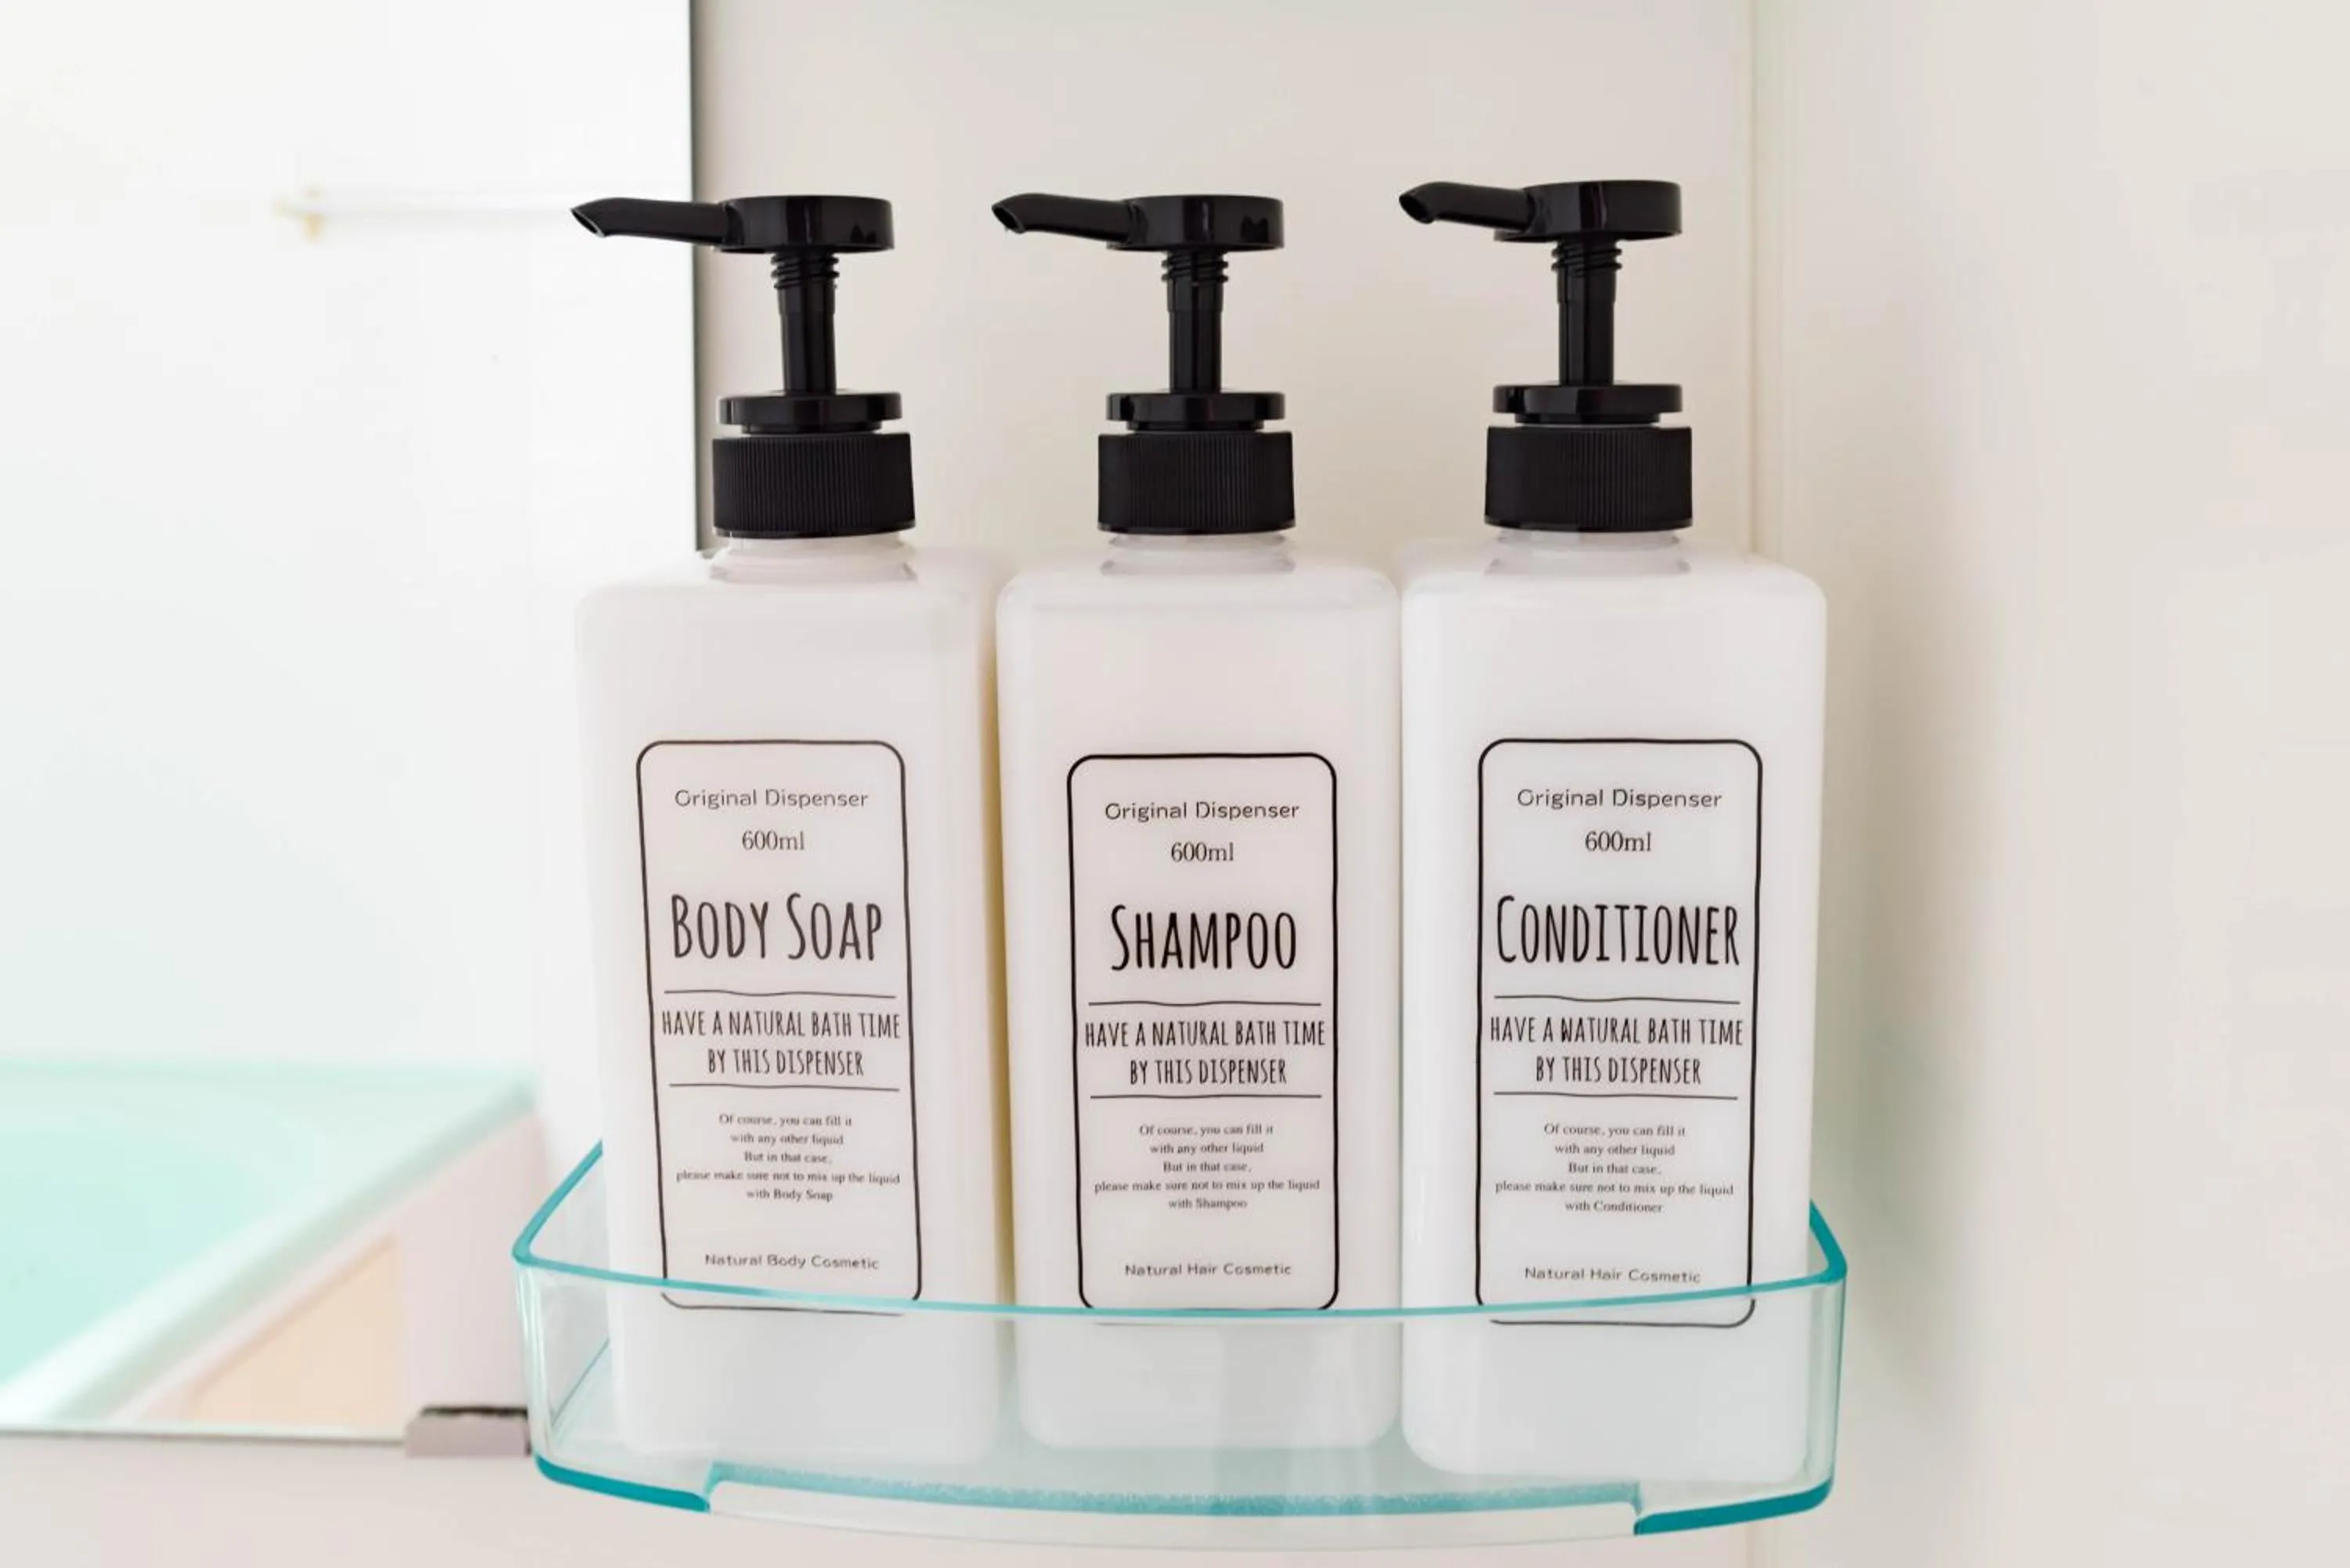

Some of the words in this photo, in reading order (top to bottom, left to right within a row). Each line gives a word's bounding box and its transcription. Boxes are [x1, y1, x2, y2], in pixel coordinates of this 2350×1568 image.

[674, 789, 757, 810] Original
[765, 789, 869, 810] Dispenser
[1517, 789, 1603, 810] Original
[1613, 789, 1722, 810] Dispenser
[1105, 802, 1187, 822] Original
[1196, 801, 1300, 821] Dispenser
[742, 830, 804, 851] 600ml
[1585, 830, 1651, 851] 600ml
[1171, 842, 1233, 862] 600ml
[671, 894, 768, 959] BODY
[786, 892, 882, 961] SOAP
[1497, 895, 1739, 965] CONDITIONER
[1111, 904, 1296, 971] SHAMPOO
[662, 1010, 706, 1036] HAVE
[712, 1010, 723, 1035] A
[729, 1010, 805, 1037] NATURAL
[812, 1011, 851, 1037] BATH
[858, 1013, 900, 1039] TIME
[1086, 1022, 1128, 1047] HAVE
[1135, 1021, 1146, 1046] A
[1152, 1021, 1228, 1046] NATURAL
[1235, 1020, 1275, 1046] BATH
[1283, 1021, 1325, 1046] TIME
[1491, 1017, 1535, 1042] HAVE
[1542, 1017, 1553, 1042] A
[1560, 1017, 1640, 1044] NATURAL
[1648, 1017, 1690, 1044] BATH
[1698, 1019, 1742, 1046] TIME
[708, 1049, 725, 1074] BY
[733, 1049, 770, 1075] THIS
[776, 1050, 863, 1076] DISPENSER
[1130, 1060, 1148, 1085] BY
[1155, 1059, 1192, 1085] THIS
[1198, 1058, 1286, 1084] DISPENSER
[1536, 1056, 1555, 1082] BY
[1562, 1056, 1601, 1082] THIS
[1608, 1057, 1701, 1084] DISPENSER
[719, 1114, 733, 1124] Of
[779, 1117, 800, 1128] you
[826, 1115, 841, 1127] fill
[845, 1118, 851, 1126] it
[1139, 1125, 1155, 1136] Of
[1200, 1126, 1220, 1137] you
[1224, 1125, 1243, 1135] can
[1246, 1123, 1262, 1135] fill
[1266, 1125, 1273, 1134] it
[1544, 1123, 1560, 1134] Of
[1608, 1128, 1629, 1138] you
[1657, 1125, 1674, 1136] fill
[1678, 1128, 1685, 1136] it
[730, 1133, 754, 1143] with
[757, 1135, 776, 1147] any
[779, 1133, 809, 1144] other
[811, 1133, 844, 1147] liquid
[1150, 1143, 1174, 1154] with
[1177, 1145, 1197, 1155] any
[1200, 1142, 1227, 1153] other
[1232, 1141, 1264, 1155] liquid
[744, 1151, 764, 1162] But
[767, 1151, 778, 1162] in
[780, 1151, 801, 1162] that
[1555, 1143, 1580, 1154] with
[1583, 1146, 1604, 1157] any
[1607, 1143, 1637, 1154] other
[1640, 1144, 1675, 1158] liquid
[1163, 1161, 1182, 1172] But
[1187, 1162, 1197, 1172] in
[1199, 1162, 1220, 1172] that
[1568, 1162, 1588, 1173] But
[1593, 1162, 1603, 1173] in
[1607, 1162, 1629, 1174] that
[676, 1169, 710, 1183] please
[714, 1170, 743, 1180] make
[747, 1172, 769, 1181] sure
[772, 1172, 790, 1181] not
[793, 1172, 804, 1181] to
[807, 1172, 827, 1182] mix
[831, 1174, 845, 1185] up
[848, 1172, 865, 1183] the
[869, 1172, 900, 1187] liquid
[1094, 1181, 1129, 1195] please
[1132, 1180, 1162, 1190] make
[1166, 1182, 1188, 1191] sure
[1191, 1181, 1209, 1190] not
[1212, 1180, 1223, 1190] to
[1226, 1180, 1247, 1190] mix
[1250, 1182, 1265, 1193] up
[1267, 1180, 1284, 1190] the
[1288, 1179, 1320, 1192] liquid
[747, 1188, 770, 1199] with
[773, 1188, 802, 1202] Body
[806, 1189, 833, 1203] Soap
[1495, 1180, 1531, 1194] please
[1535, 1181, 1566, 1191] make
[1570, 1183, 1593, 1193] sure
[1597, 1184, 1615, 1193] not
[1619, 1183, 1630, 1193] to
[1634, 1184, 1656, 1194] mix
[1660, 1185, 1676, 1197] up
[1678, 1183, 1695, 1194] the
[1700, 1183, 1734, 1198] liquid
[1169, 1198, 1192, 1209] with
[1195, 1197, 1248, 1212] Shampoo
[1565, 1200, 1591, 1211] with
[1593, 1200, 1663, 1213] Conditioner
[705, 1254, 762, 1266] Natural
[767, 1254, 806, 1269] Body
[811, 1255, 878, 1270] Cosmetic
[1125, 1263, 1182, 1277] Natural
[1187, 1263, 1217, 1275] Hair
[1223, 1263, 1291, 1275] Cosmetic
[1525, 1266, 1585, 1280] Natural
[1590, 1268, 1622, 1281] Hair
[1628, 1268, 1700, 1284] Cosmetic
